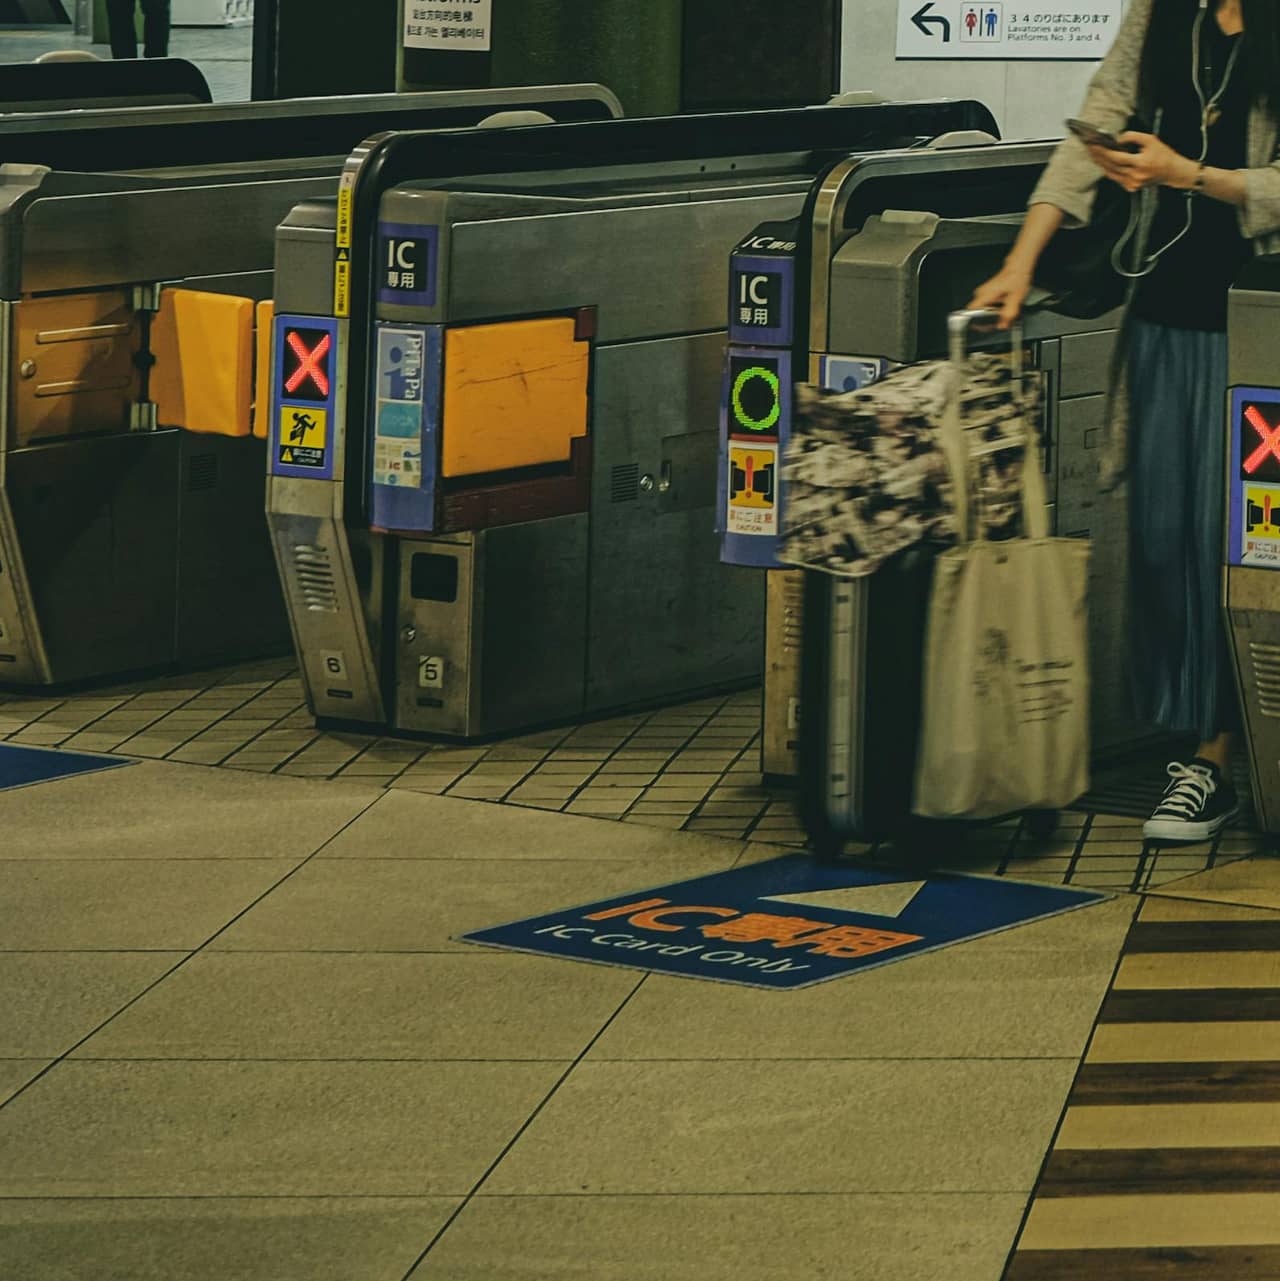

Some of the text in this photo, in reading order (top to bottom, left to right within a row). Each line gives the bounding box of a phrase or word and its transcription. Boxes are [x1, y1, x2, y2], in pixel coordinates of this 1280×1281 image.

[1034, 14, 1110, 24] のりばにあります
[1008, 33, 1048, 41] Platforms
[388, 240, 415, 269] IC
[388, 273, 415, 288] 専用
[740, 275, 767, 305] IC
[740, 308, 767, 325] 専用
[405, 334, 423, 400] PiTaPa
[327, 657, 340, 673] 6
[425, 663, 437, 680] 5
[583, 898, 925, 958] IC専用
[534, 924, 812, 974] IC Card Only
